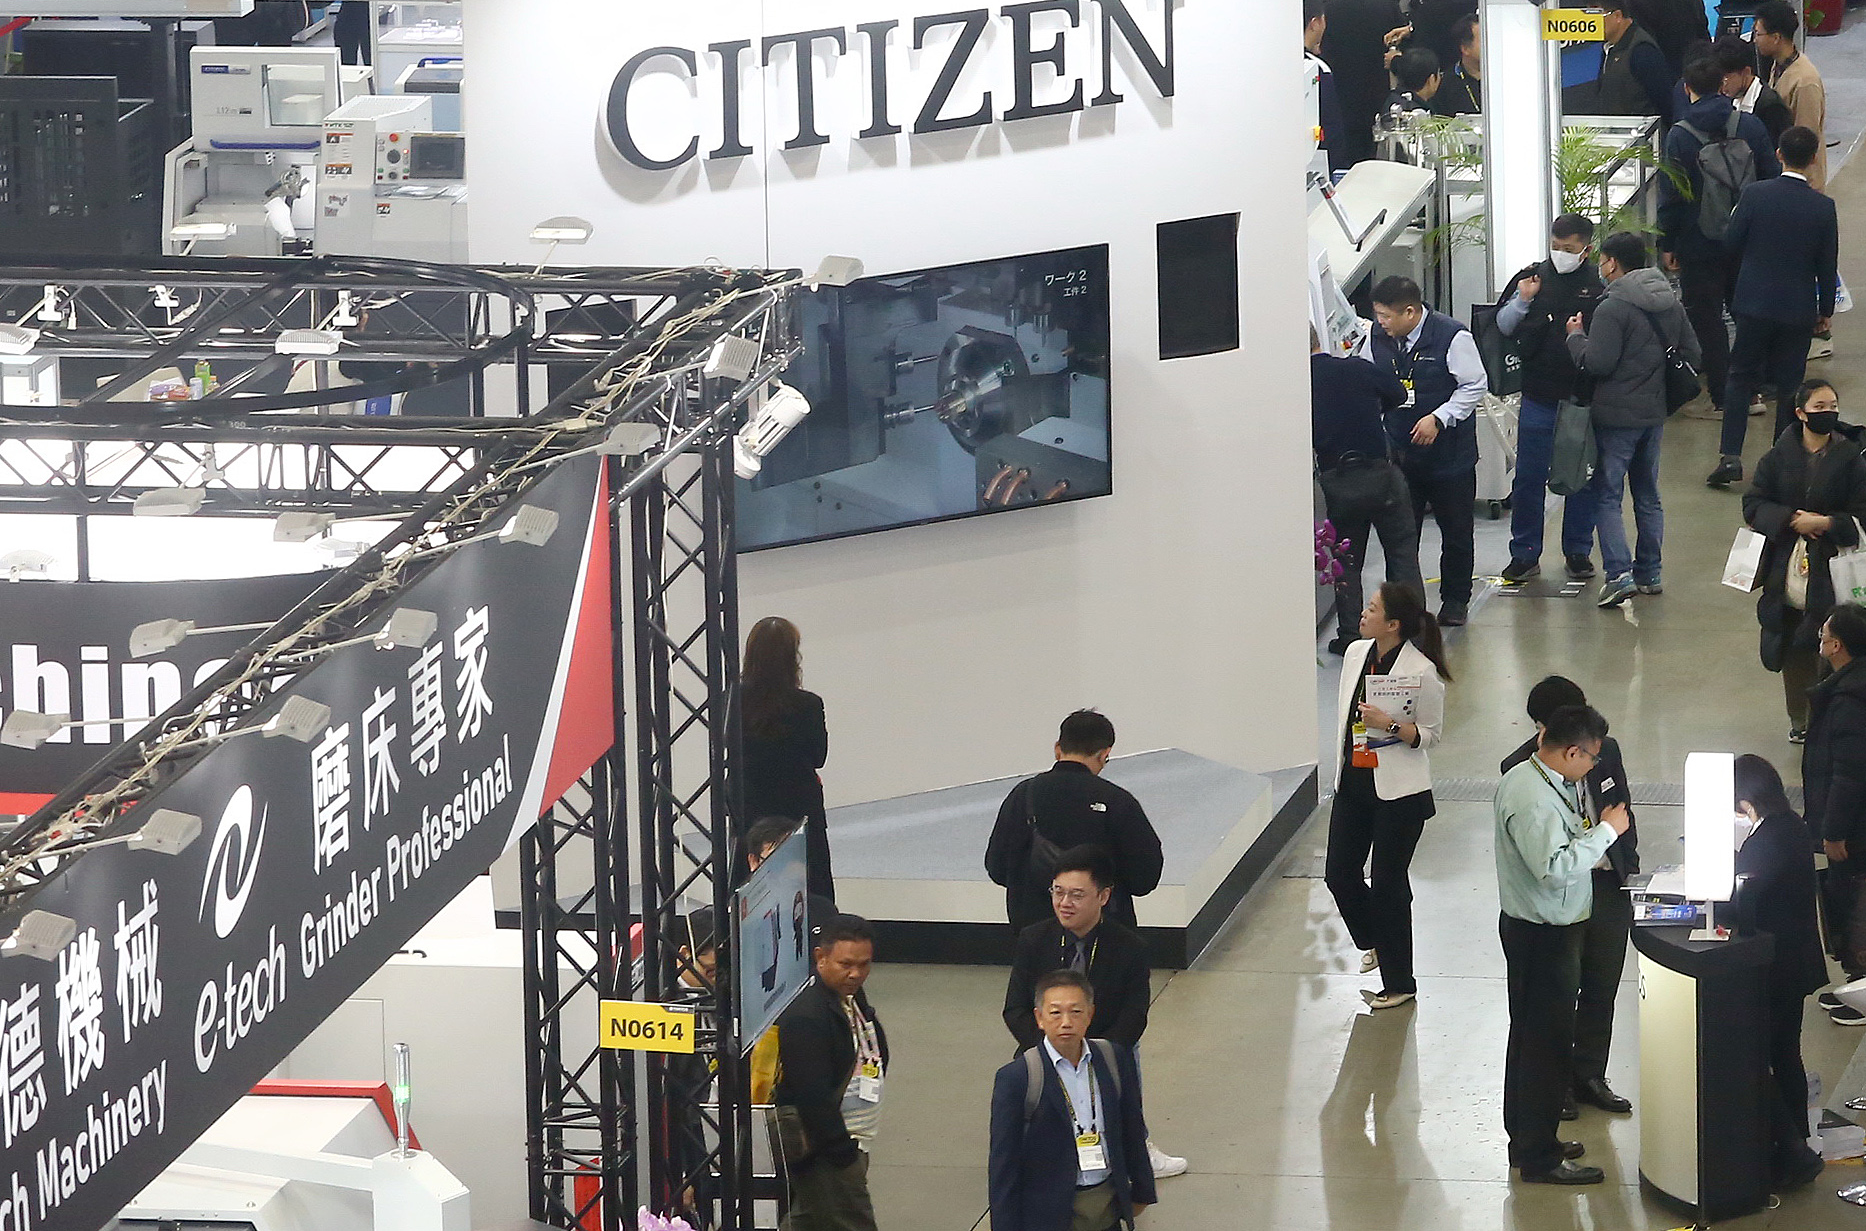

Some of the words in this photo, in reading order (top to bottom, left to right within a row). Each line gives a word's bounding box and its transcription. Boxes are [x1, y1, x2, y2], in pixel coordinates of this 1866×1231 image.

[1546, 18, 1597, 35] N0606
[1044, 271, 1076, 286] ワーク
[1077, 269, 1088, 282] 2
[1079, 284, 1088, 295] 2
[310, 604, 495, 875] 磨床專家
[301, 873, 380, 980] Grinder
[386, 732, 515, 906] Professional
[193, 925, 288, 1073] e-tech
[610, 1016, 685, 1043] N0614
[35, 1059, 168, 1223] Machinery
